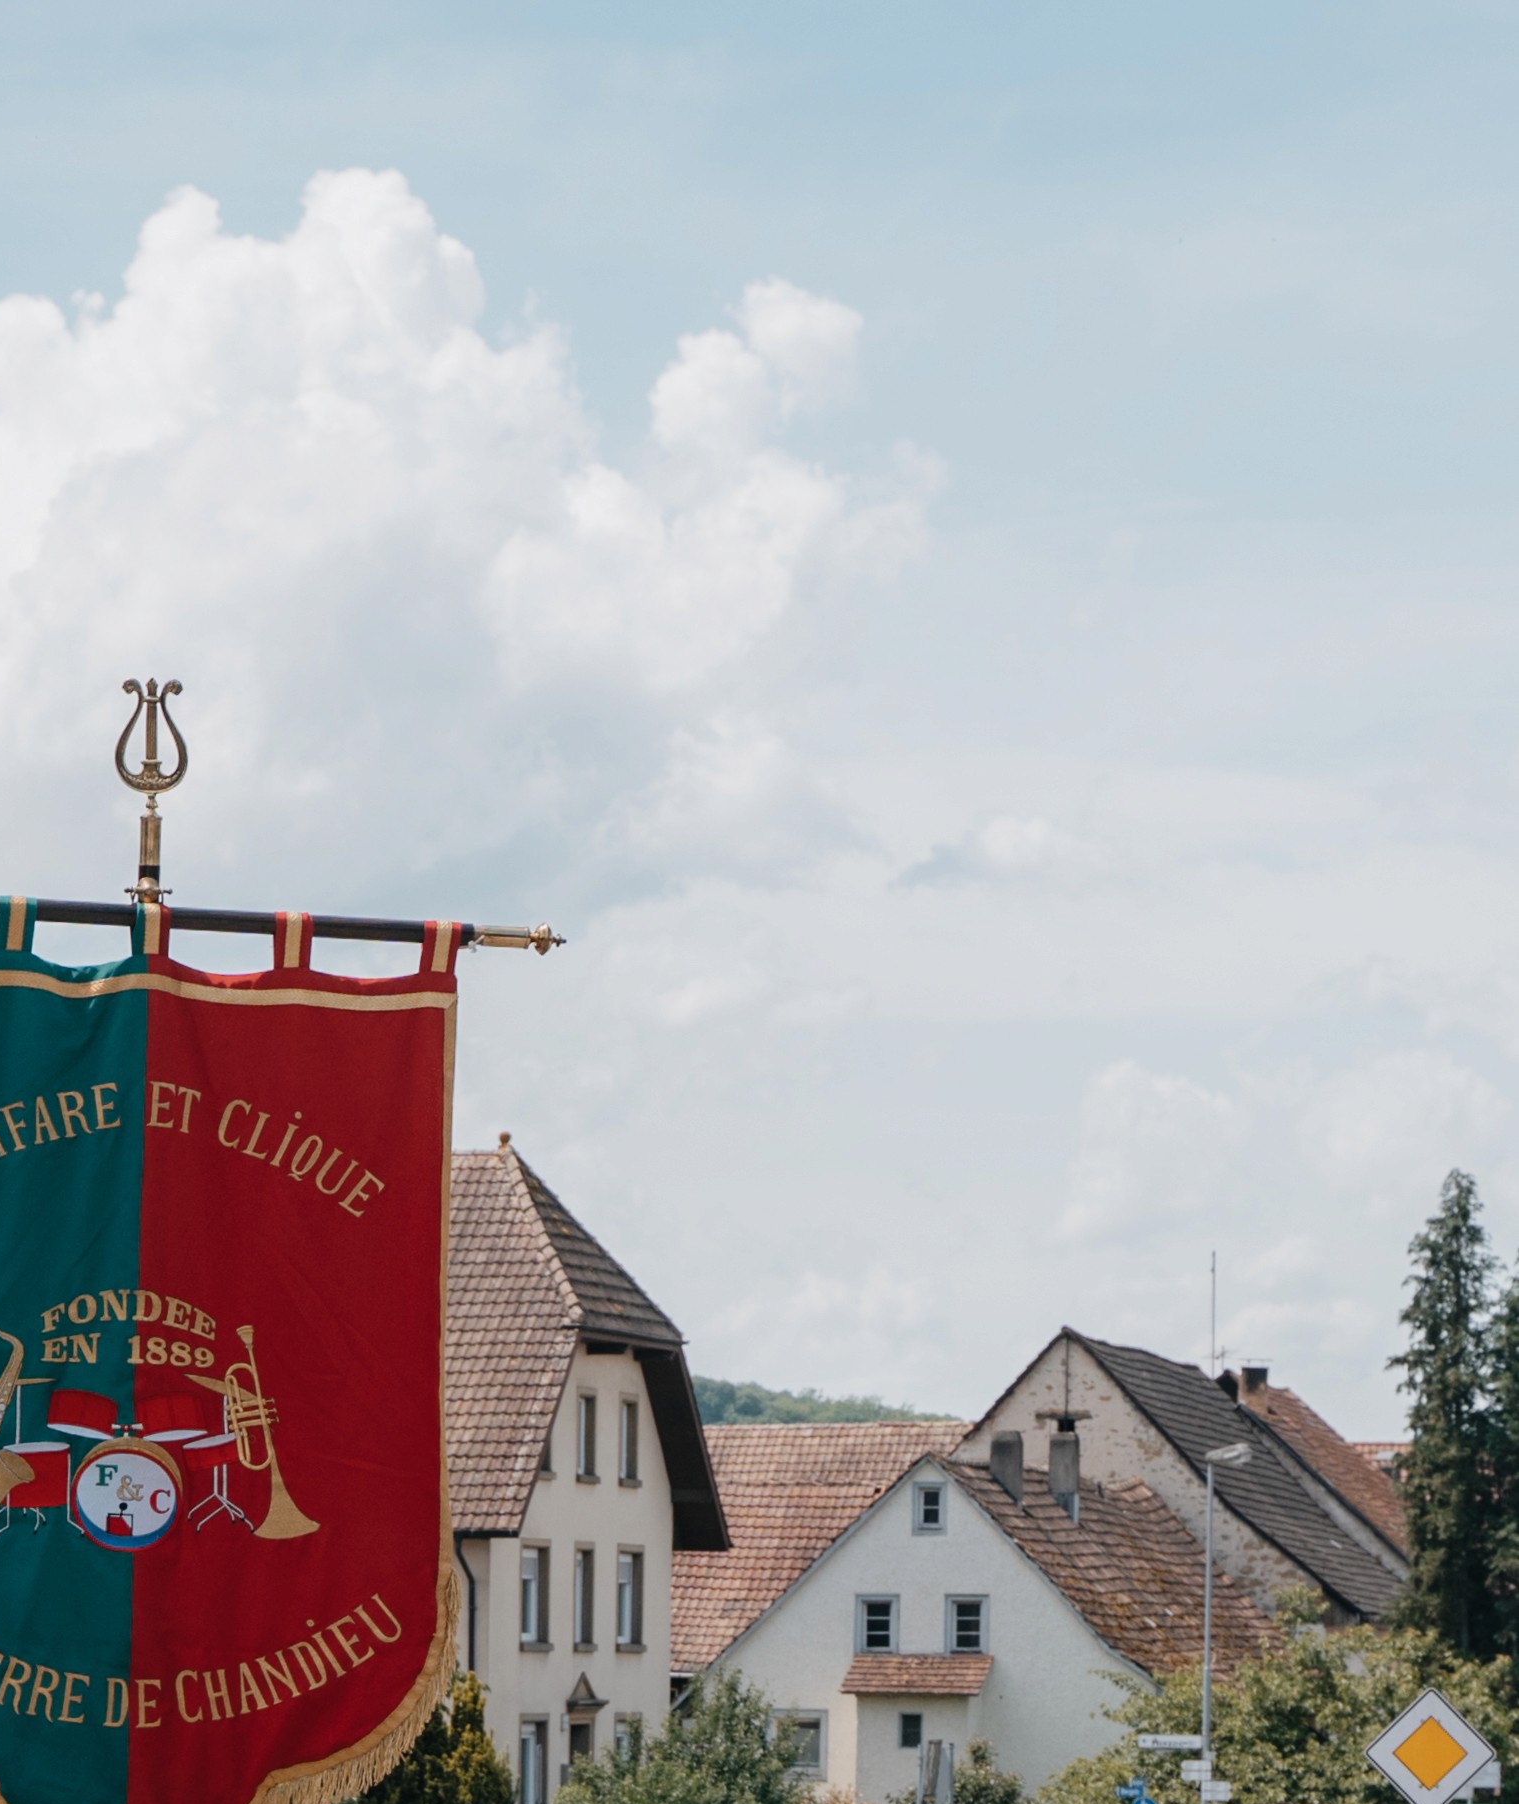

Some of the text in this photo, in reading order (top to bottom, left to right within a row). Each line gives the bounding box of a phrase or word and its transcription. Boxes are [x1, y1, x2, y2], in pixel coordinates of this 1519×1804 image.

[147, 1080, 202, 1134] ET
[40, 1289, 217, 1341] FONDEE
[40, 1333, 215, 1368] EN 1889
[102, 1677, 162, 1729] DE
